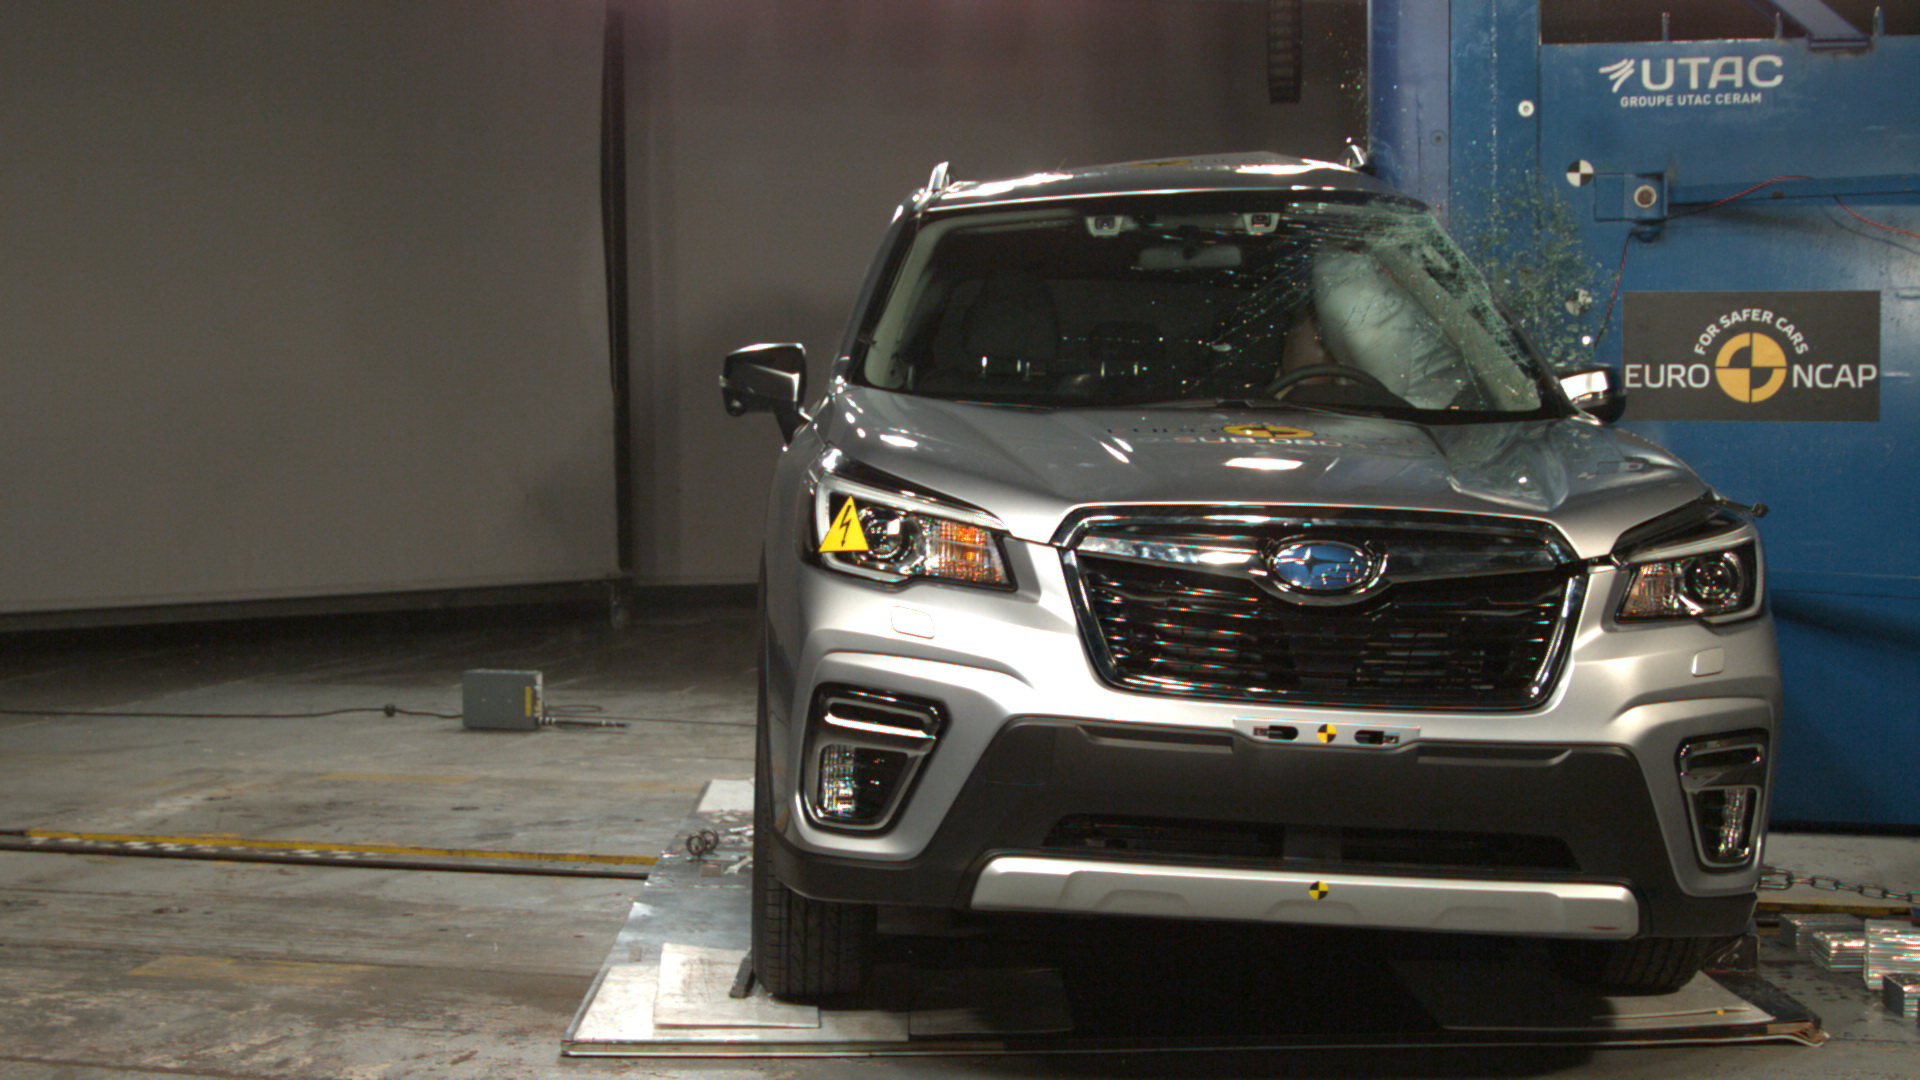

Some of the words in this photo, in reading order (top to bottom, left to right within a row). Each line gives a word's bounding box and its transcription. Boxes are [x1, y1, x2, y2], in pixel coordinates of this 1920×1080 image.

[1641, 54, 1784, 92] UTAC
[1620, 95, 1674, 108] GROUPE
[1677, 93, 1712, 106] UTAC
[1715, 92, 1762, 105] CERAM
[1693, 323, 1721, 356] FOR
[1719, 308, 1774, 328] SAFER
[1775, 316, 1809, 355] CARS
[1624, 363, 1710, 389] EURO
[1792, 363, 1878, 389] NCAP
